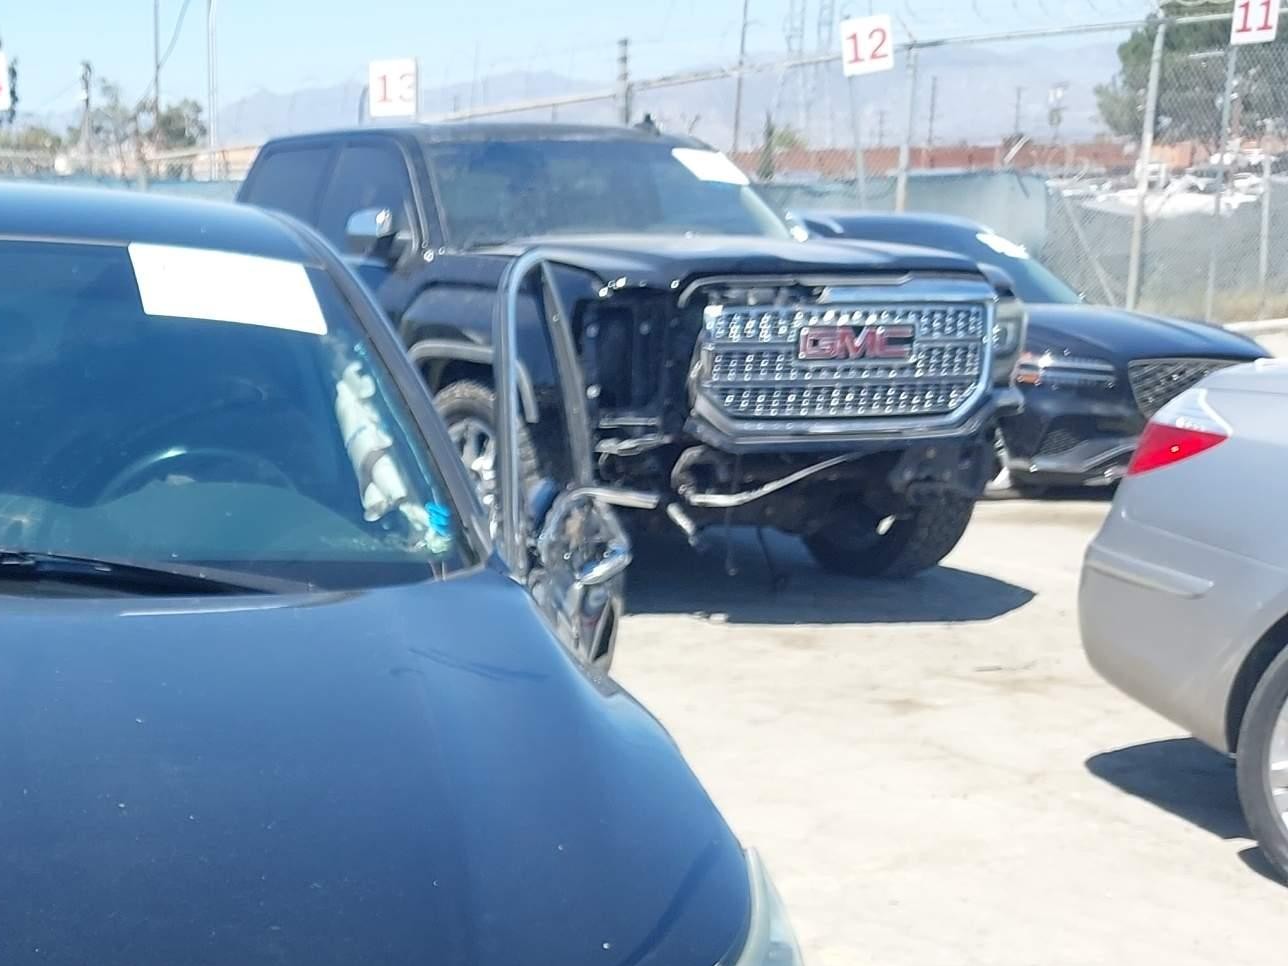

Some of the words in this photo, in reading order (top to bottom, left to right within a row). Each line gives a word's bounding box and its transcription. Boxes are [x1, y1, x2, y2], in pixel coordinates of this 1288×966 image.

[1235, 0, 1273, 33] 11
[845, 27, 889, 65] 12
[376, 72, 415, 103] 13
[799, 325, 913, 360] GMC
